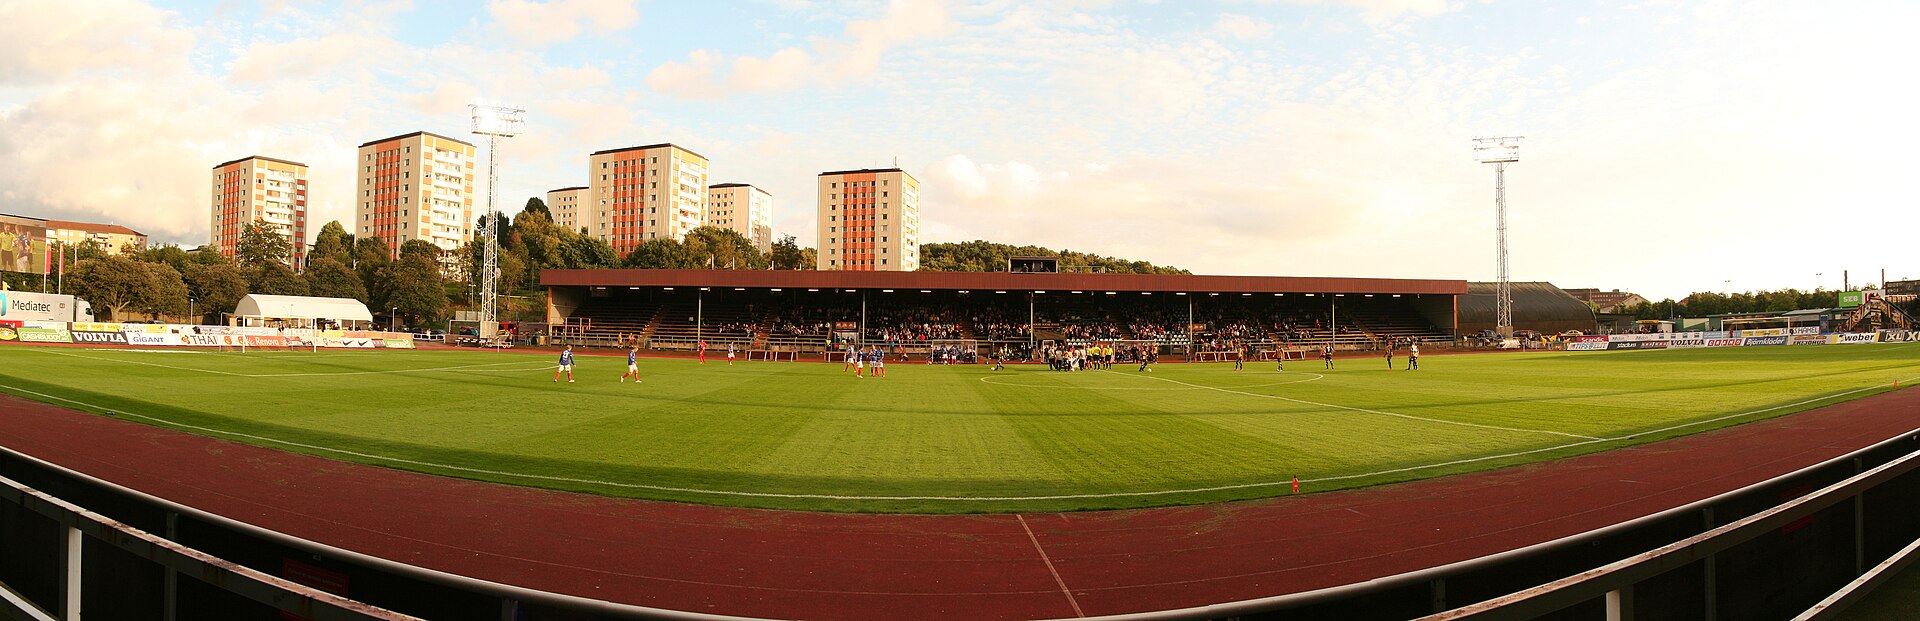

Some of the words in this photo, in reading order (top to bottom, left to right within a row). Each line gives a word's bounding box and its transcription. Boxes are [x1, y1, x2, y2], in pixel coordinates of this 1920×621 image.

[12, 299, 51, 312] Mediatec
[72, 331, 127, 343] VOLVIA
[190, 335, 218, 345] THAI
[255, 337, 279, 345] Renova
[1844, 333, 1875, 341] weber
